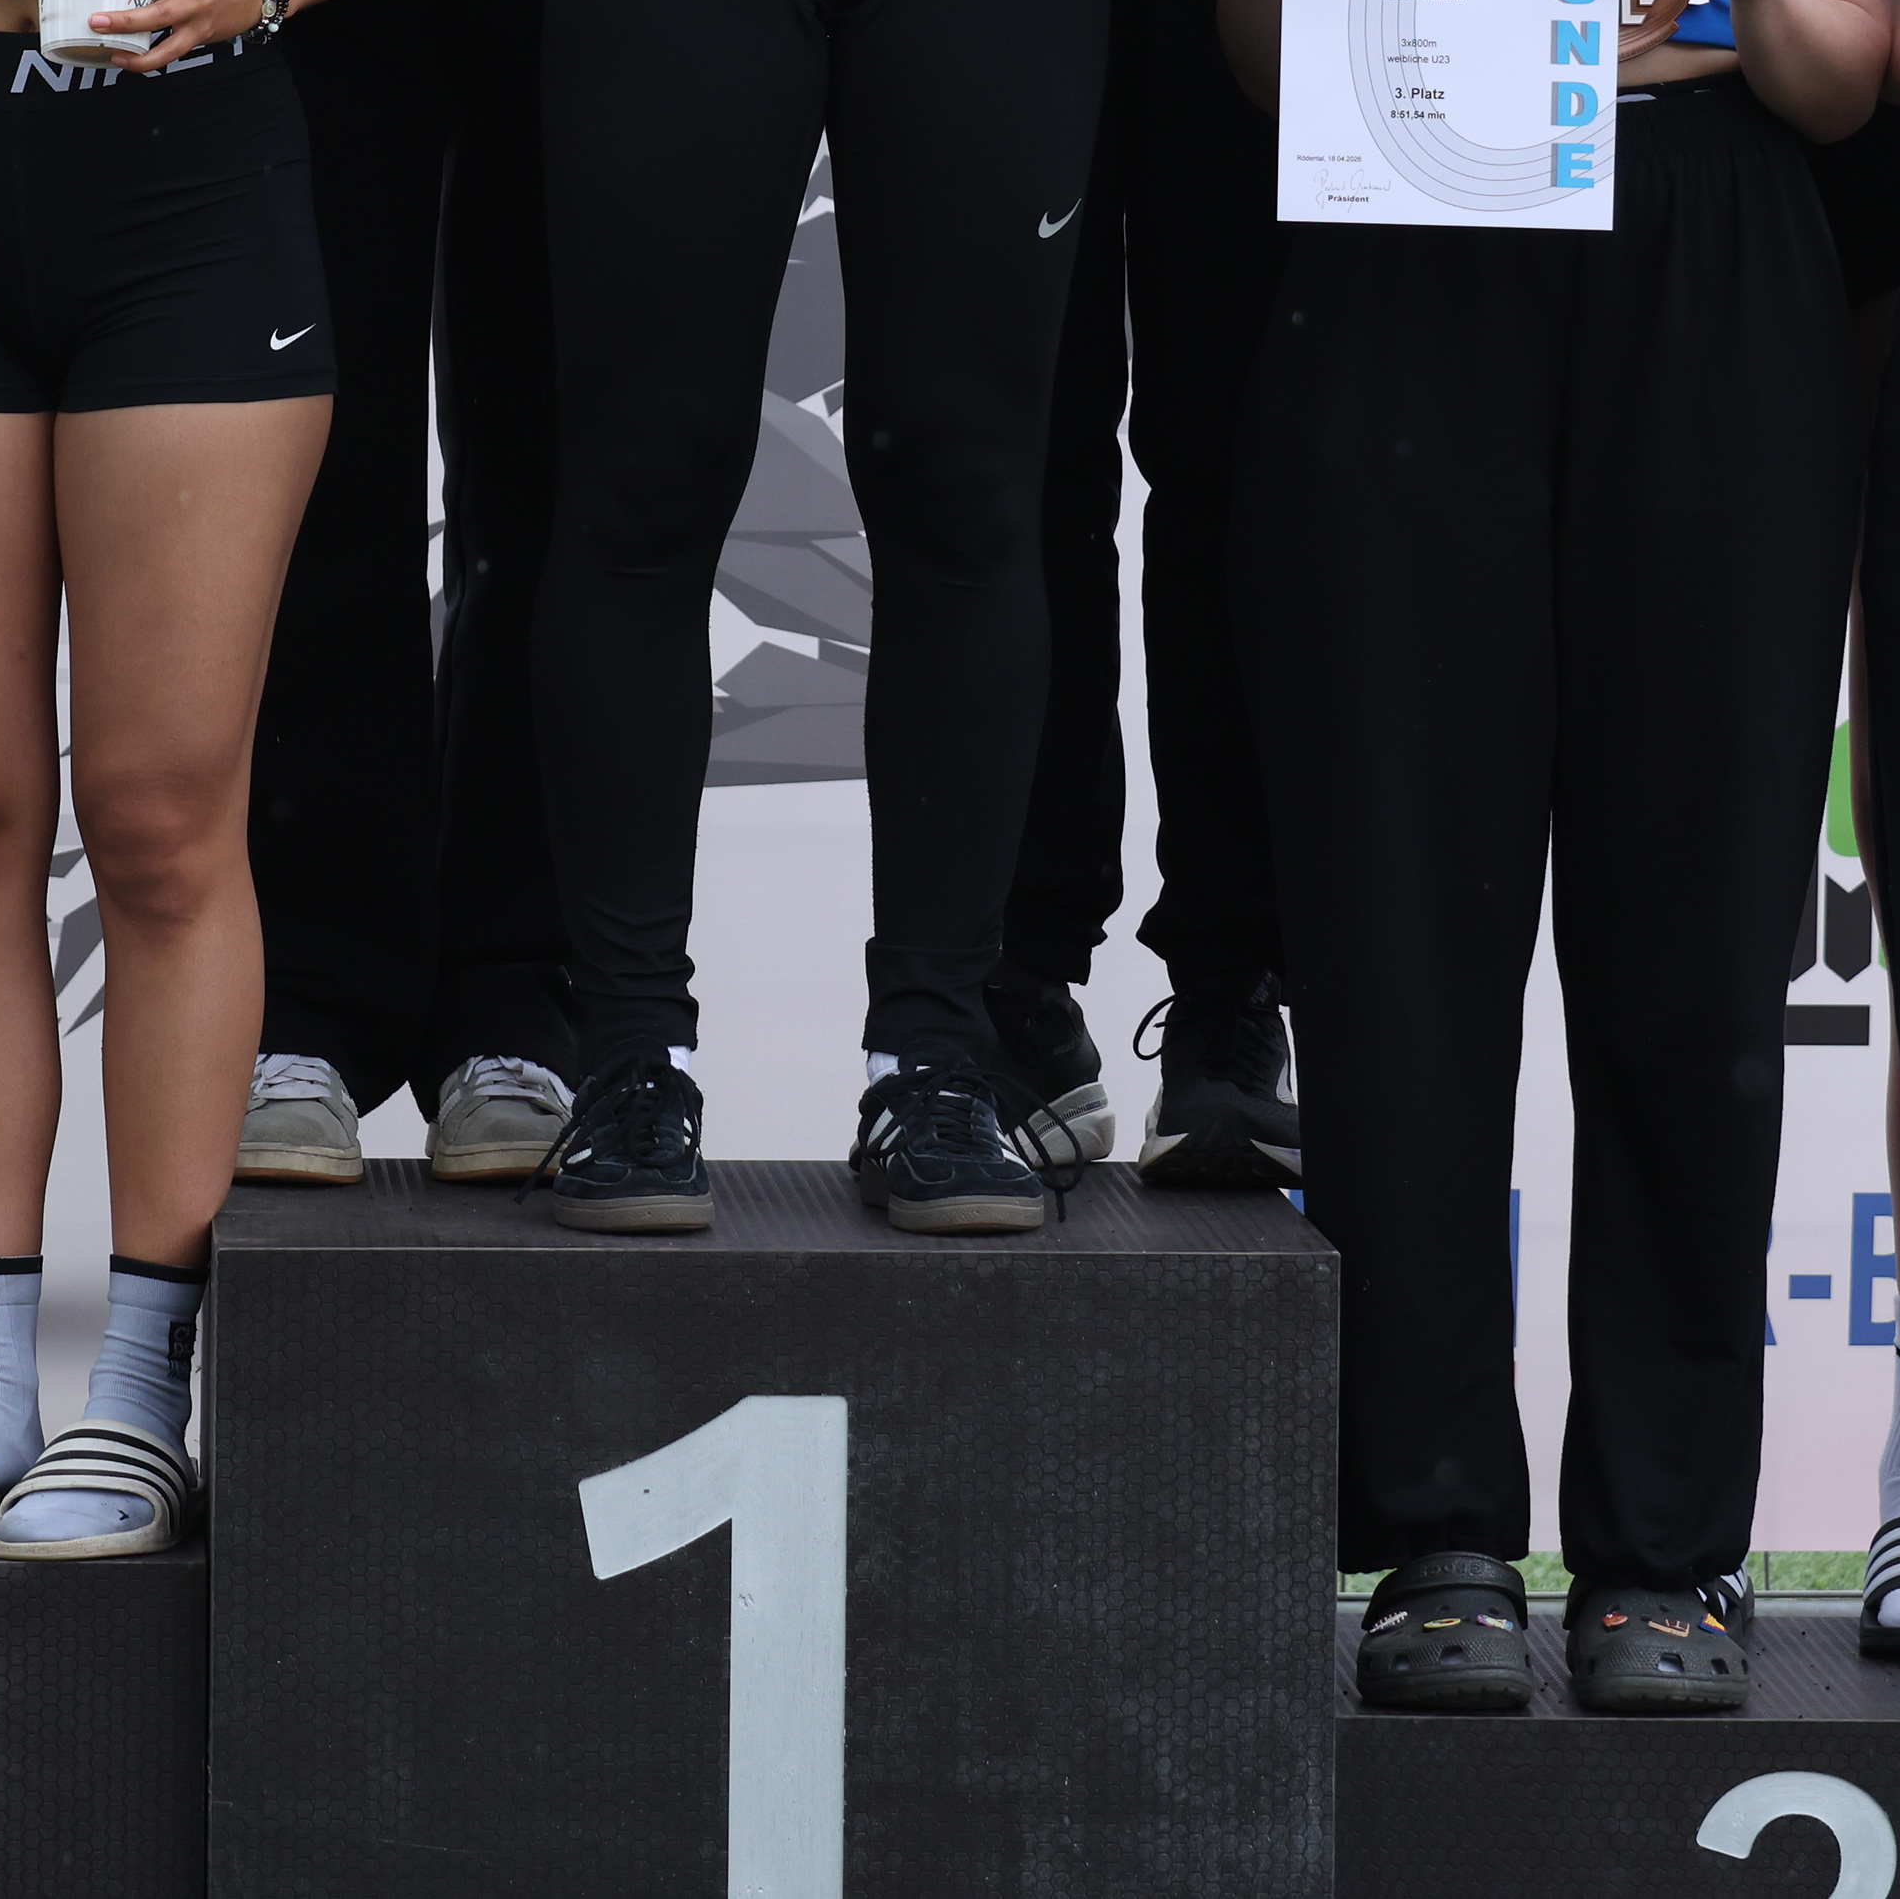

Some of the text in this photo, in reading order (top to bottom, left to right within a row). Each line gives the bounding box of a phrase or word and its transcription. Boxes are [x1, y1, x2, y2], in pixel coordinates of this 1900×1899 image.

[1400, 38, 1437, 49] 3x800m
[1387, 54, 1451, 65] weibliche U23
[1395, 87, 1445, 100] 3. Platz
[1427, 110, 1446, 120] min
[577, 1394, 849, 1899] 1
